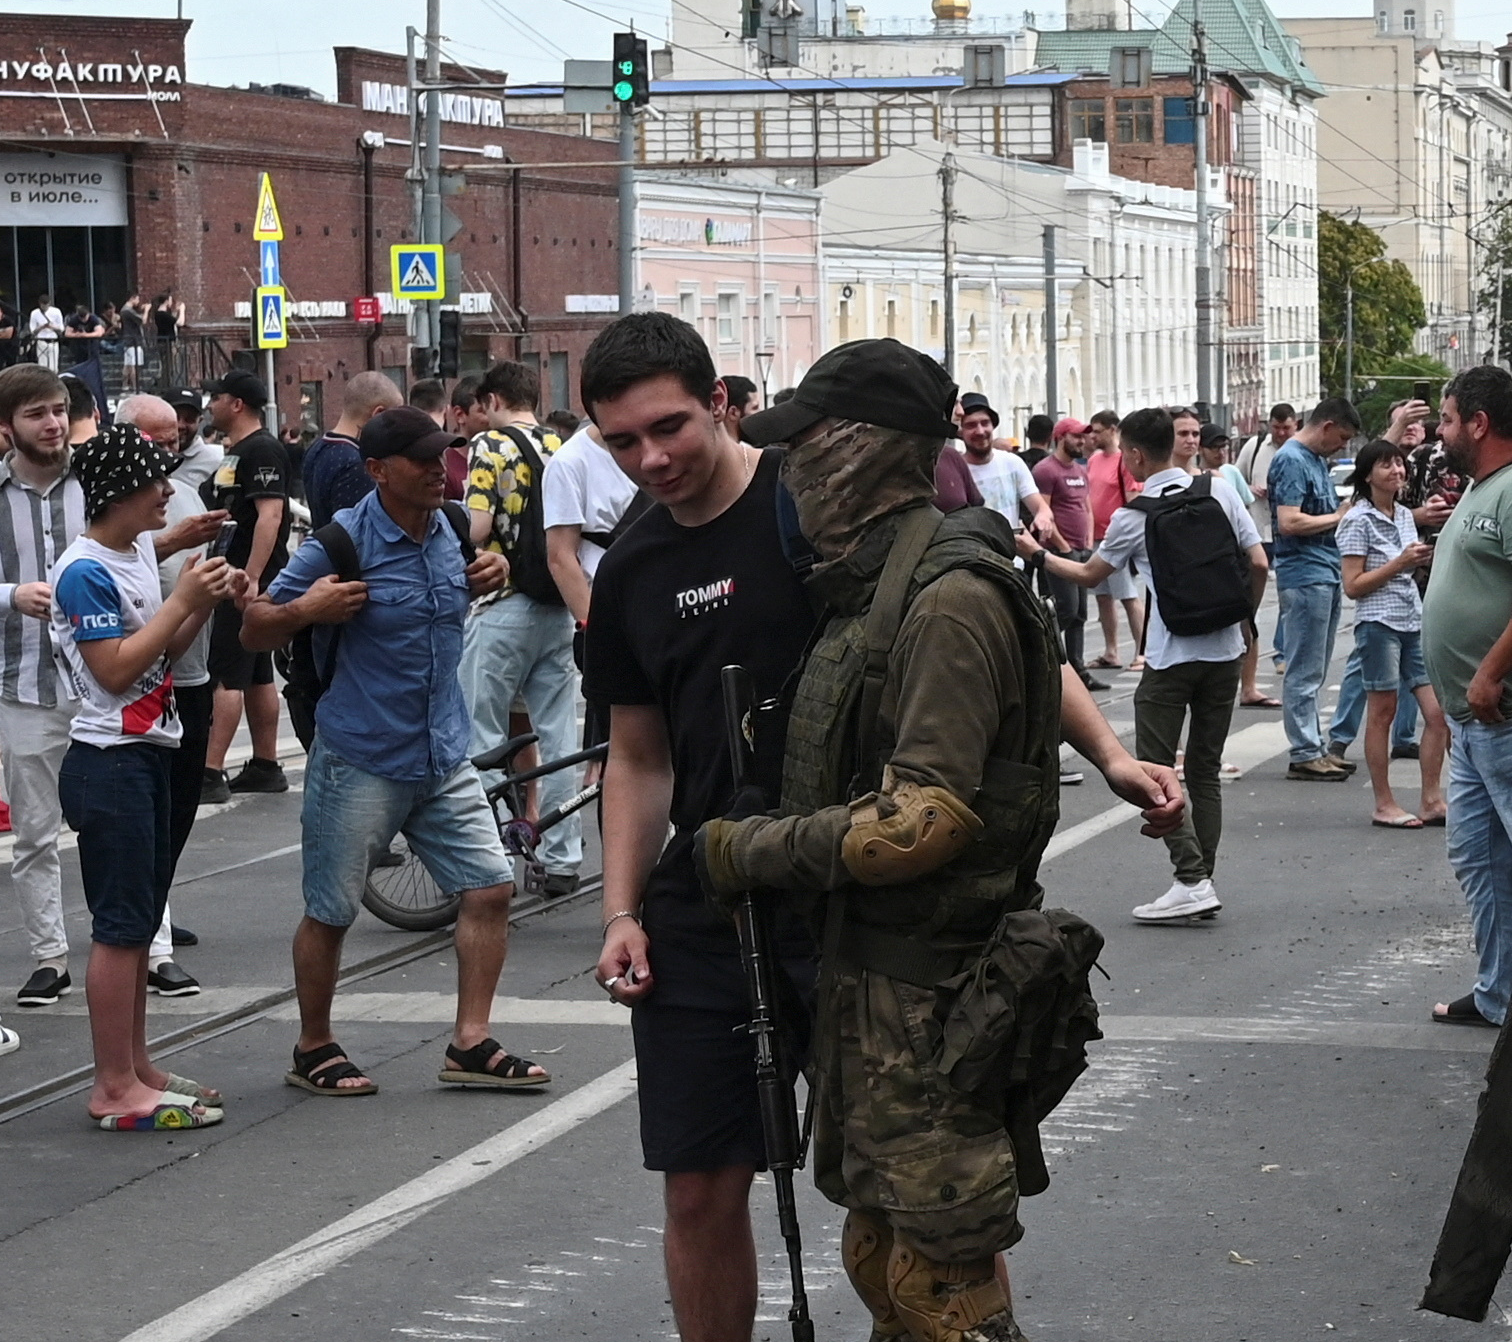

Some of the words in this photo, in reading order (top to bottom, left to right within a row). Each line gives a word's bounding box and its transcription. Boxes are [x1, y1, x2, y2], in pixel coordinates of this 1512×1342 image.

[4, 172, 102, 187] открытие
[11, 191, 22, 203] в
[676, 577, 732, 609] TOMMY
[681, 598, 729, 619] JEANS
[82, 612, 119, 630] ПСБ
